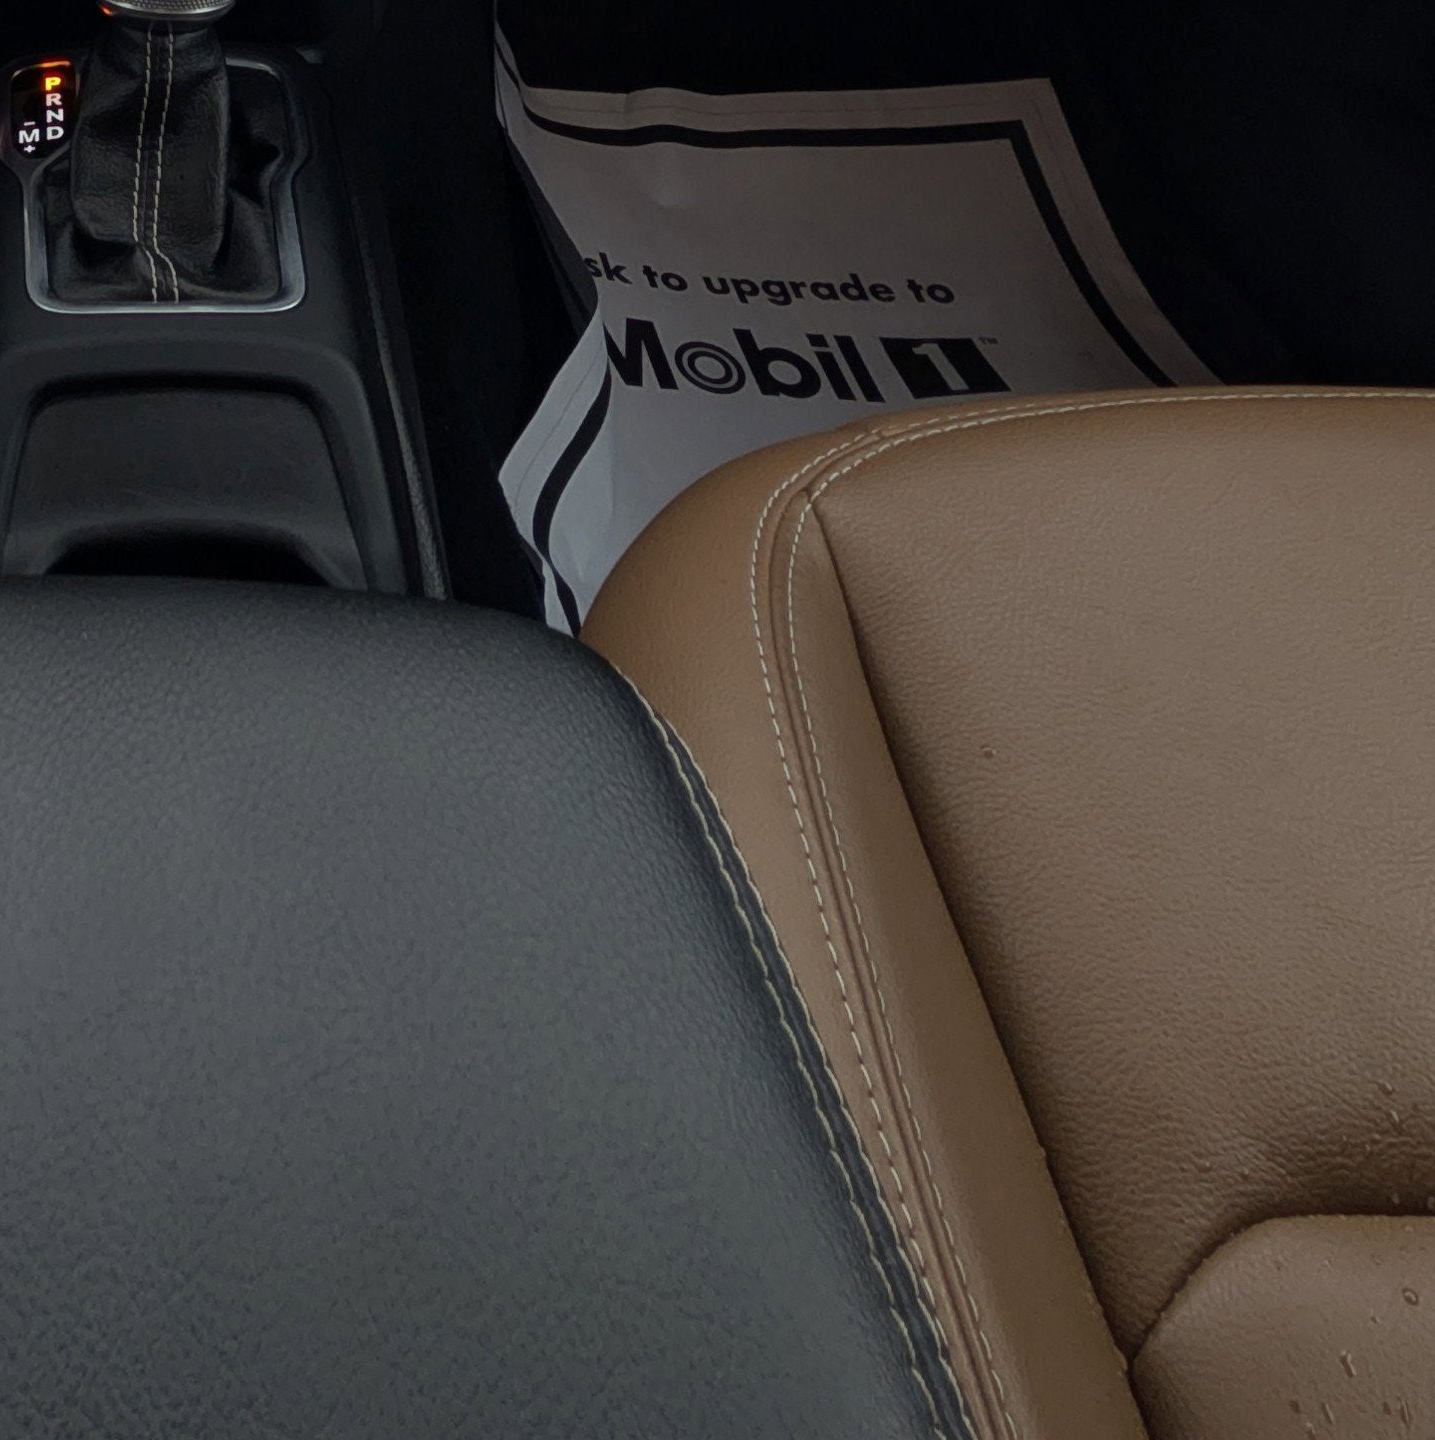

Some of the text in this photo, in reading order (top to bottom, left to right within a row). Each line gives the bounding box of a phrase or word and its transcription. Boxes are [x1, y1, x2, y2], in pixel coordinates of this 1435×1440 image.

[45, 77, 61, 91] P
[46, 93, 62, 107] R
[46, 108, 64, 123] N
[19, 128, 40, 144] M
[46, 126, 64, 140] D
[584, 252, 955, 307] sk to upgrade to
[602, 317, 886, 403] Mobil
